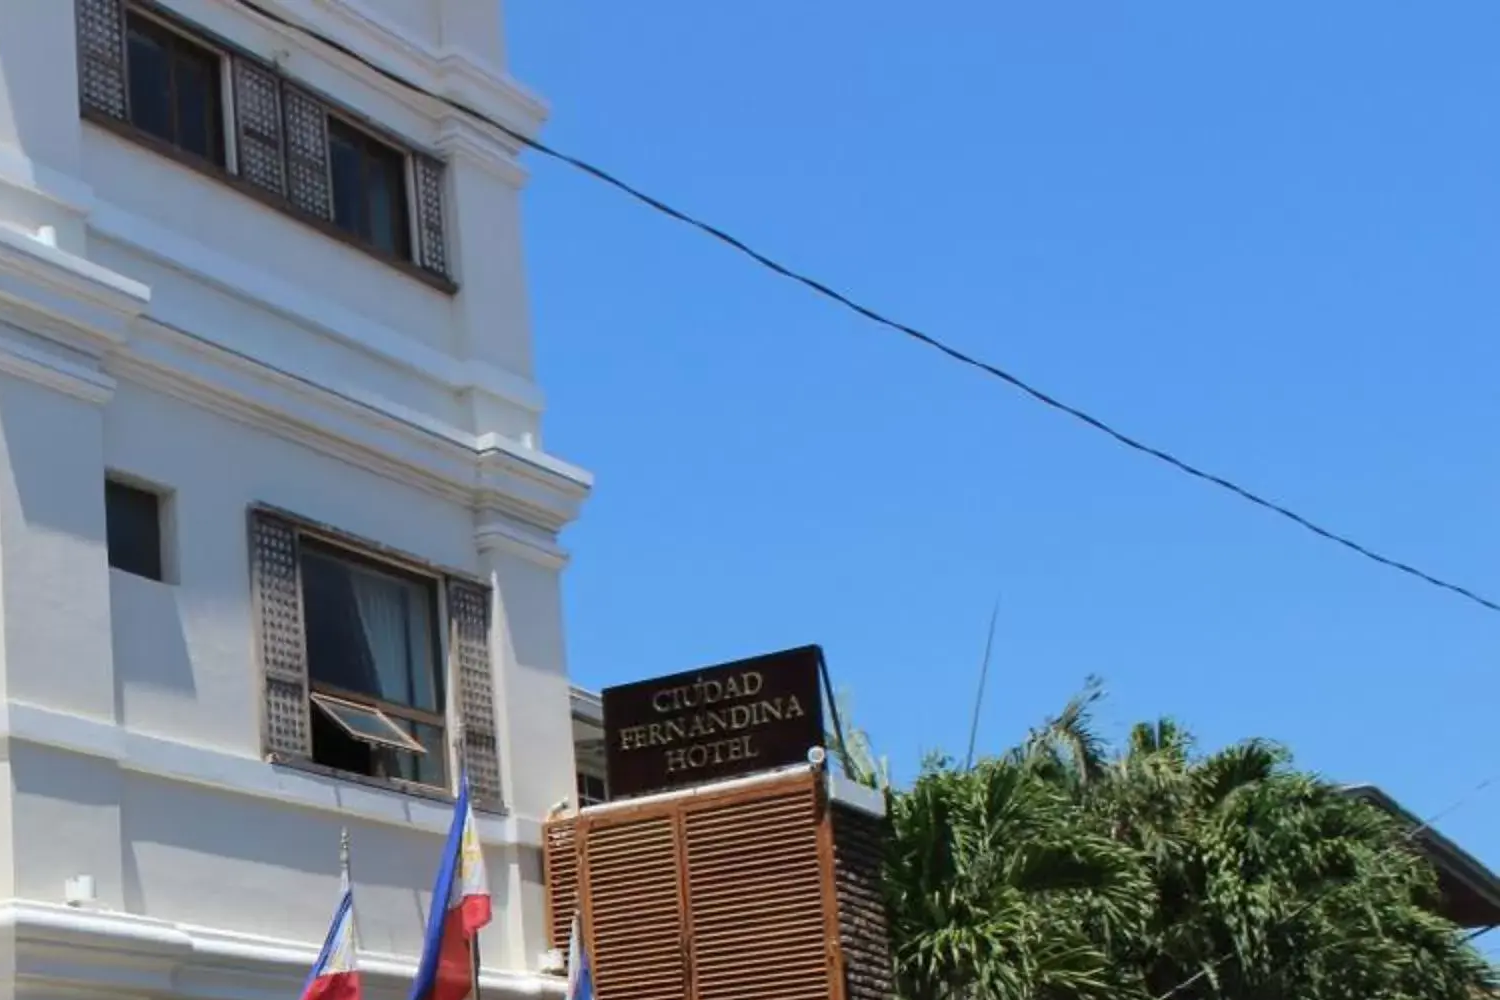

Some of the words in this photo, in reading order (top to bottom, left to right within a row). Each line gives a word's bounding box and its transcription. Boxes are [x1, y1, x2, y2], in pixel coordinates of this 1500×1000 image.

[652, 671, 763, 713] CIUDAD
[619, 694, 804, 750] FERNANDINA
[666, 735, 759, 772] HOTEL
